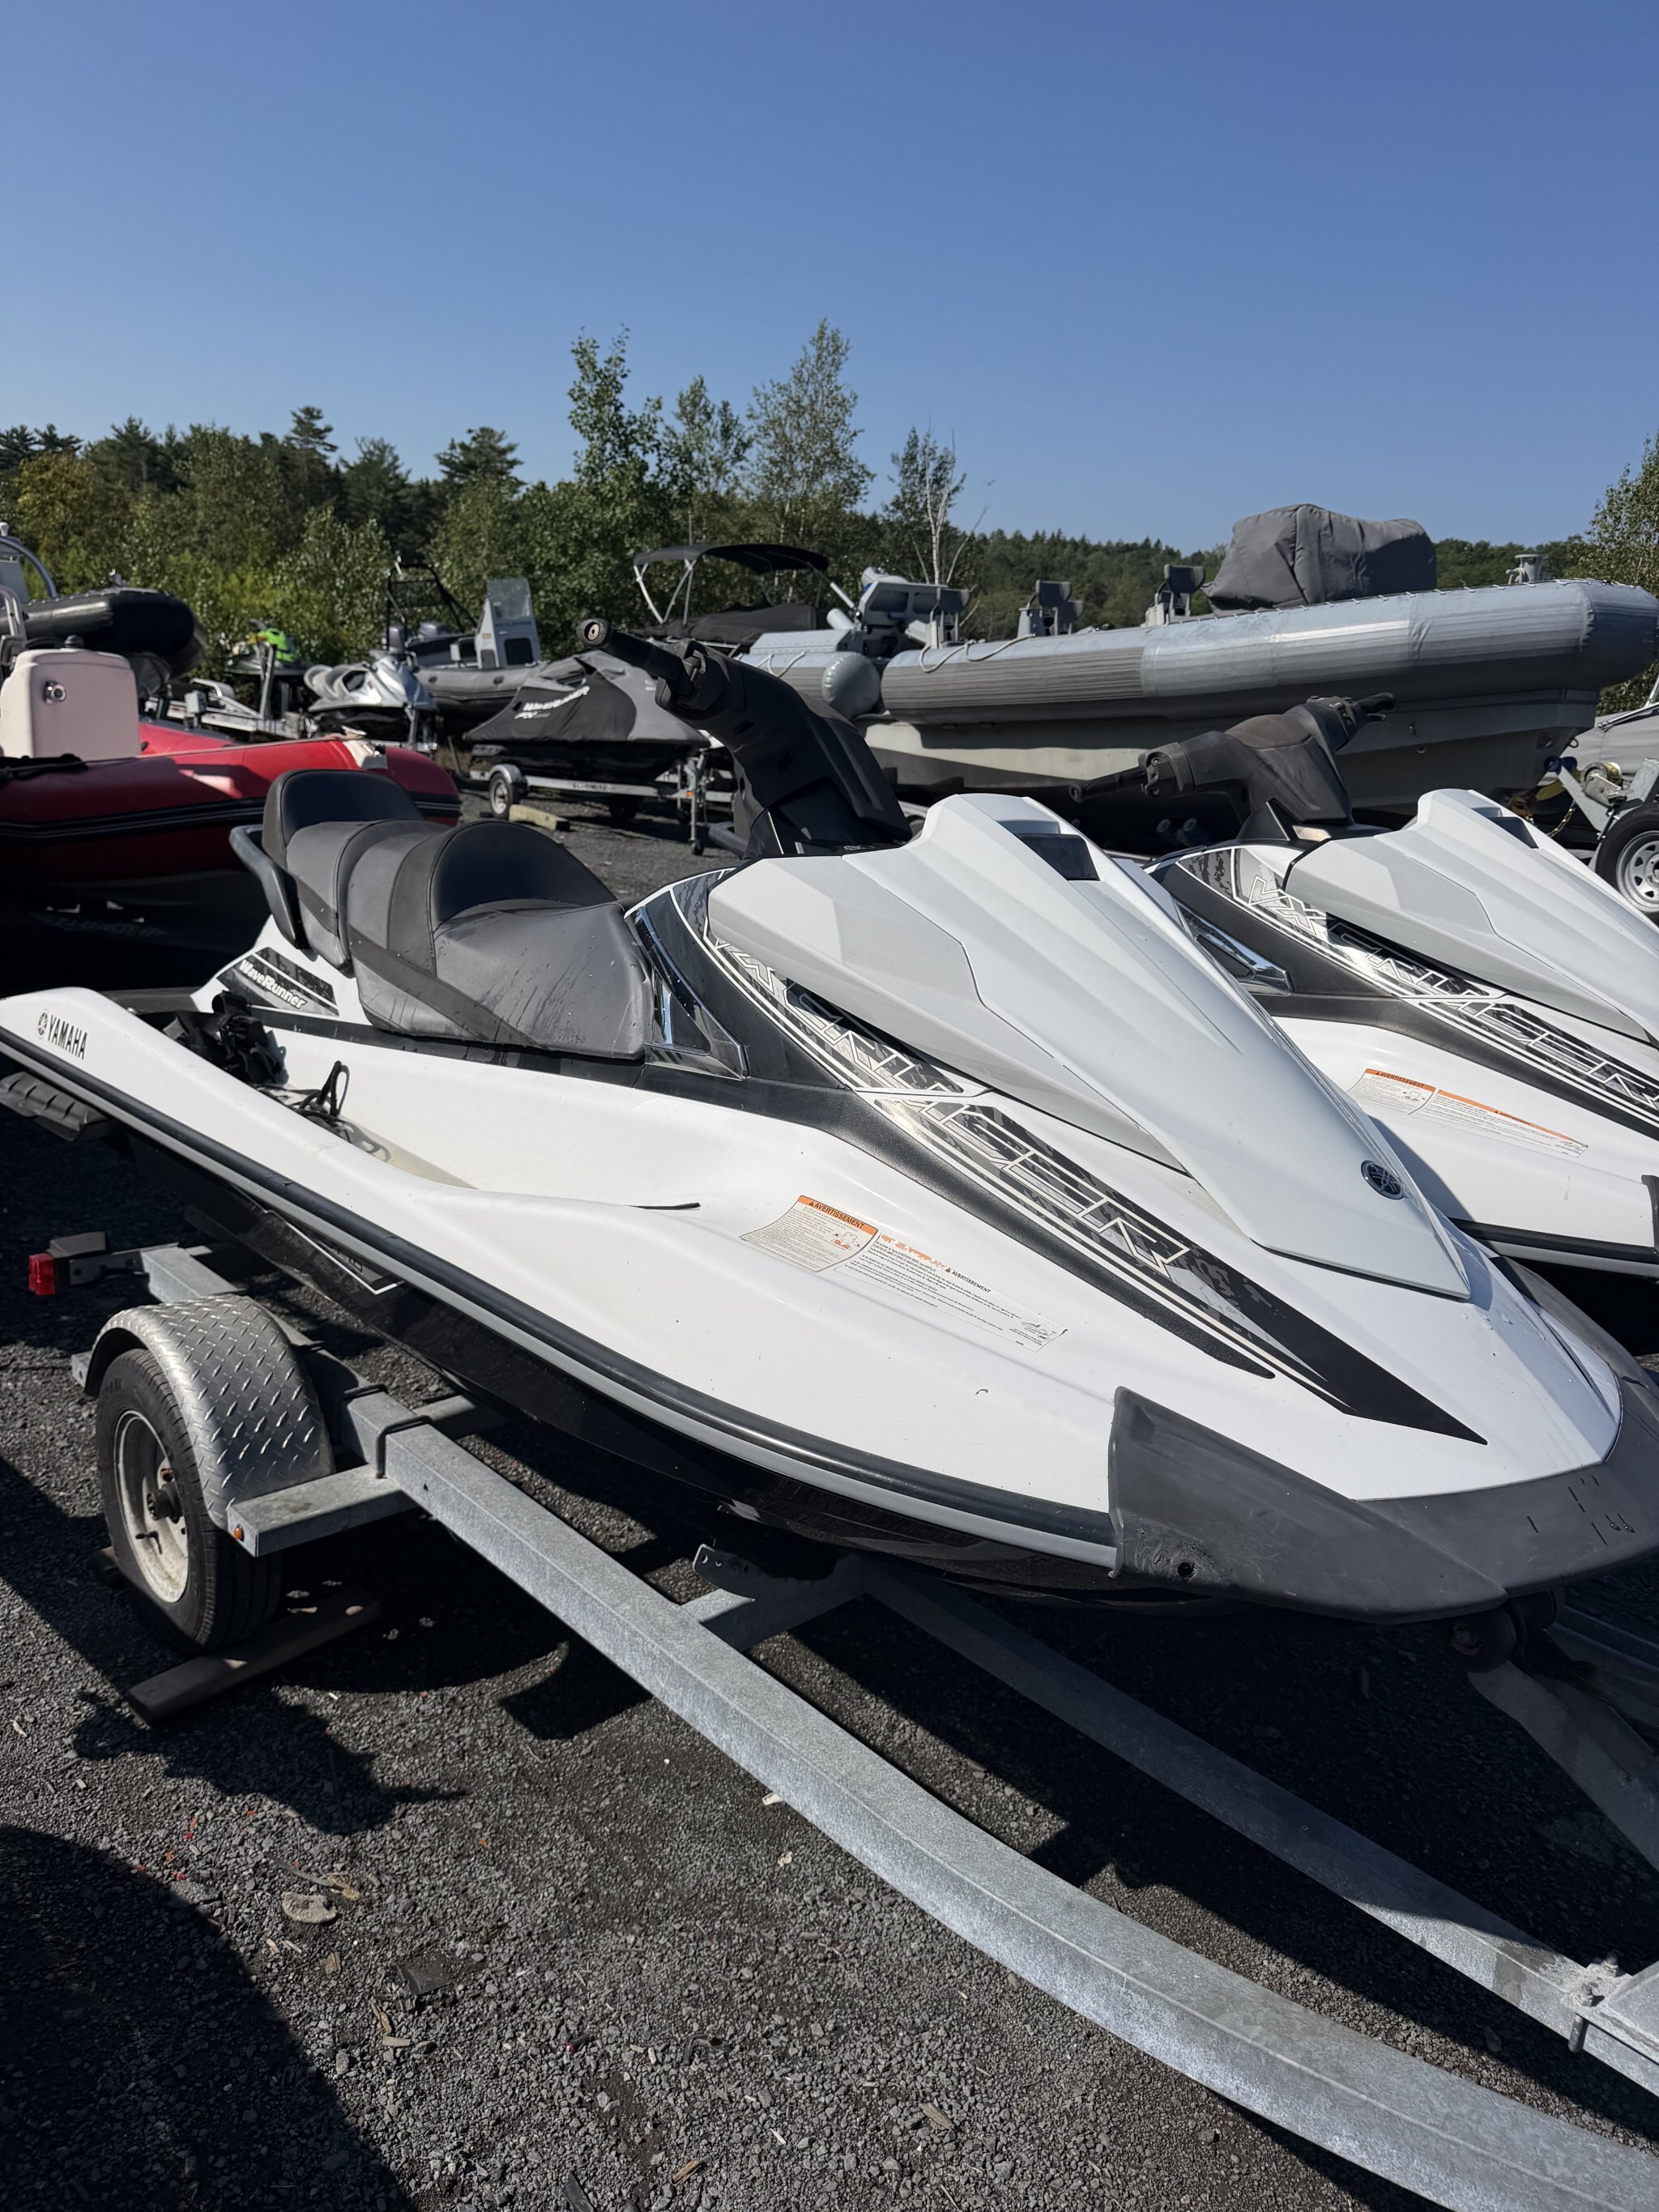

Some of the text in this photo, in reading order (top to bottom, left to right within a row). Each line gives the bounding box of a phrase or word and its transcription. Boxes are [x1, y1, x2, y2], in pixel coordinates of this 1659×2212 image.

[239, 959, 306, 1009] WaveRunner
[48, 1014, 87, 1060] YAMAHA
[1380, 1072, 1426, 1089] AVERTISSEMENT
[813, 1202, 865, 1230] AVERTISSEMENT
[951, 1269, 992, 1294] AVERTISSEMENT
